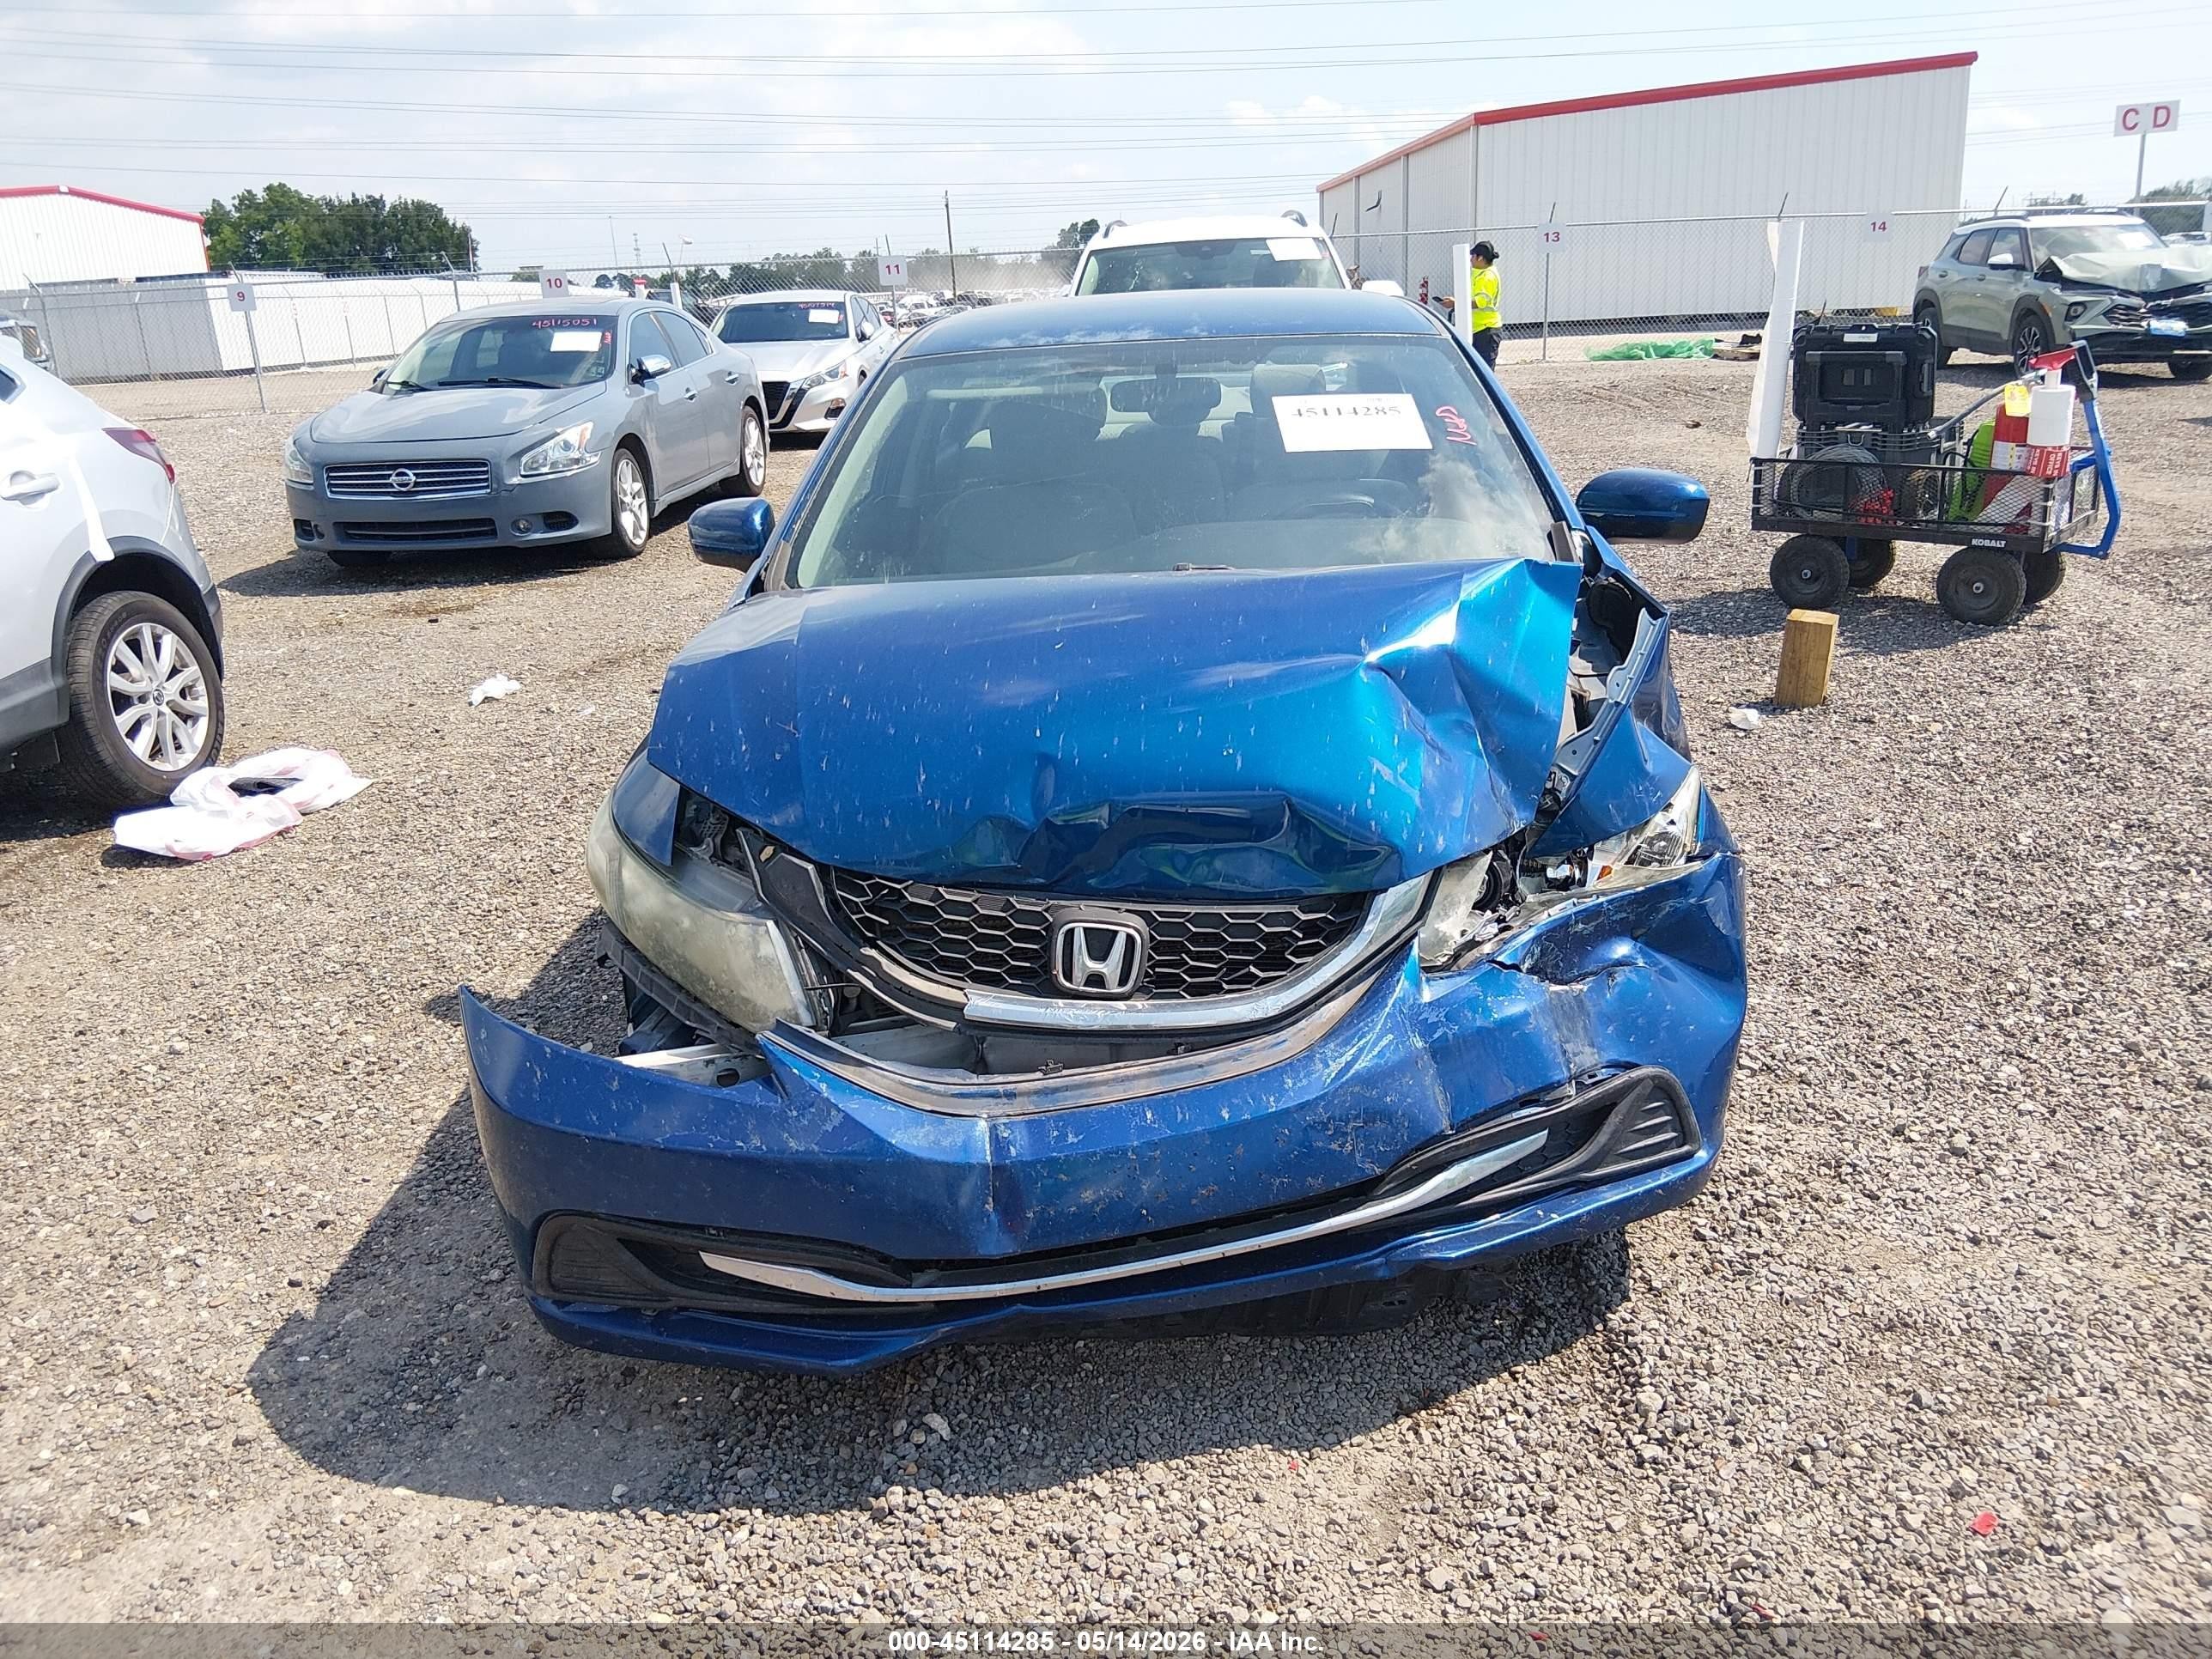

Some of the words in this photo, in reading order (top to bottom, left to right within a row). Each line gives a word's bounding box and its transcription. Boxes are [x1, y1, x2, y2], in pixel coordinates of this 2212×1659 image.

[2122, 107, 2140, 131] C
[2152, 105, 2172, 129] D
[1870, 221, 1887, 233] 14
[1543, 231, 1560, 243] 13
[884, 264, 901, 276] 11
[546, 277, 563, 289] 10
[235, 290, 246, 302] 9
[532, 318, 598, 330] 45115051
[1291, 405, 1403, 418] 45114285
[1971, 538, 2007, 548] KOBALT
